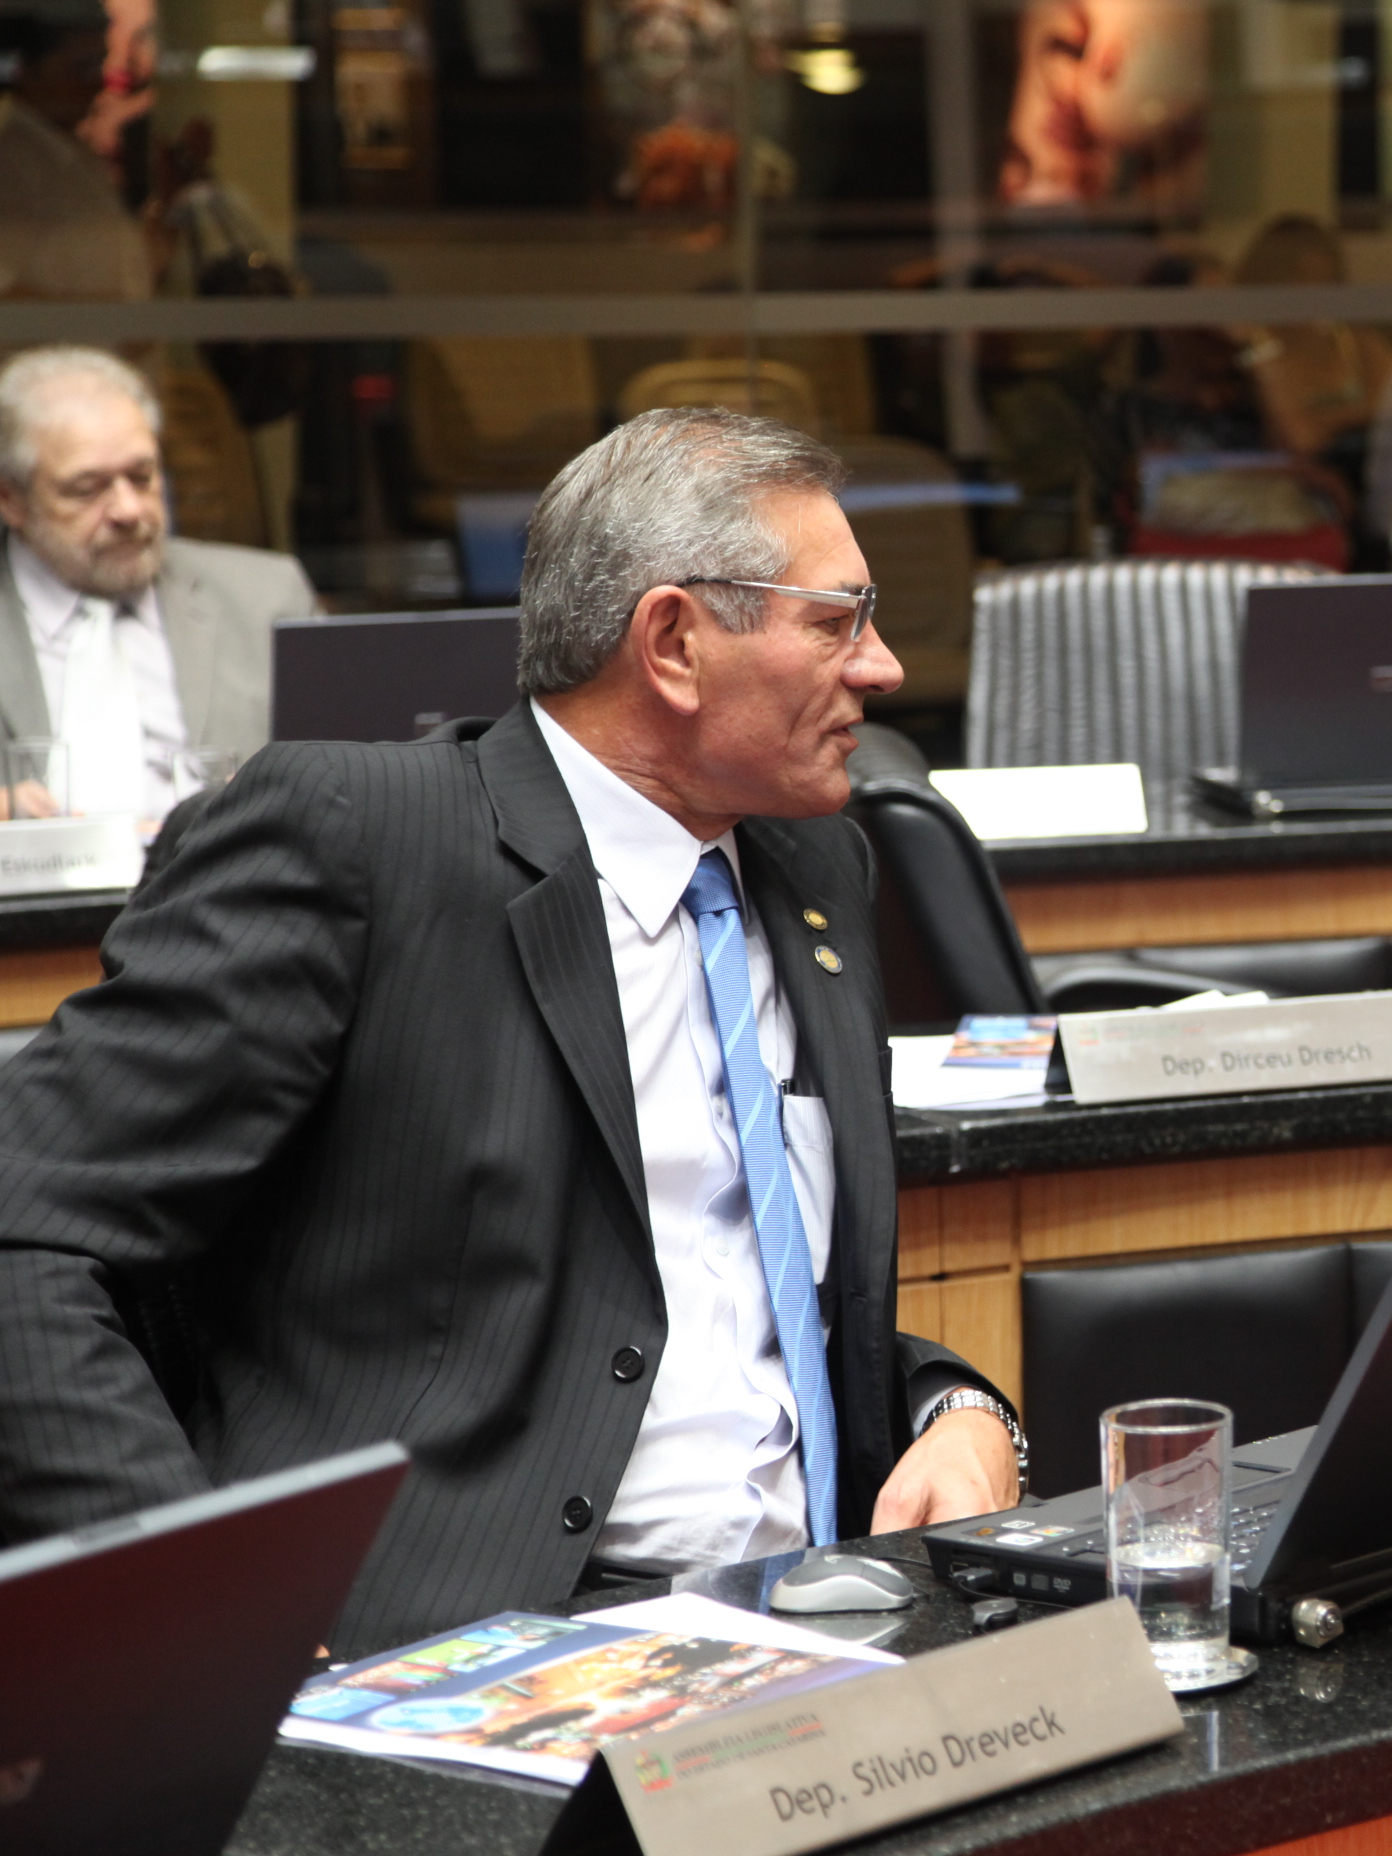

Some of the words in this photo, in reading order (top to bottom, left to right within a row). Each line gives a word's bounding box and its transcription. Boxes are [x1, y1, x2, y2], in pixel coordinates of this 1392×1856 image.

[1161, 1054, 1214, 1078] Dep.
[1220, 1050, 1293, 1072] Dirceu
[1299, 1042, 1373, 1066] Dresch
[769, 1782, 847, 1822] Dep.
[852, 1748, 937, 1797] Silvio
[941, 1705, 1065, 1768] Dreveck
